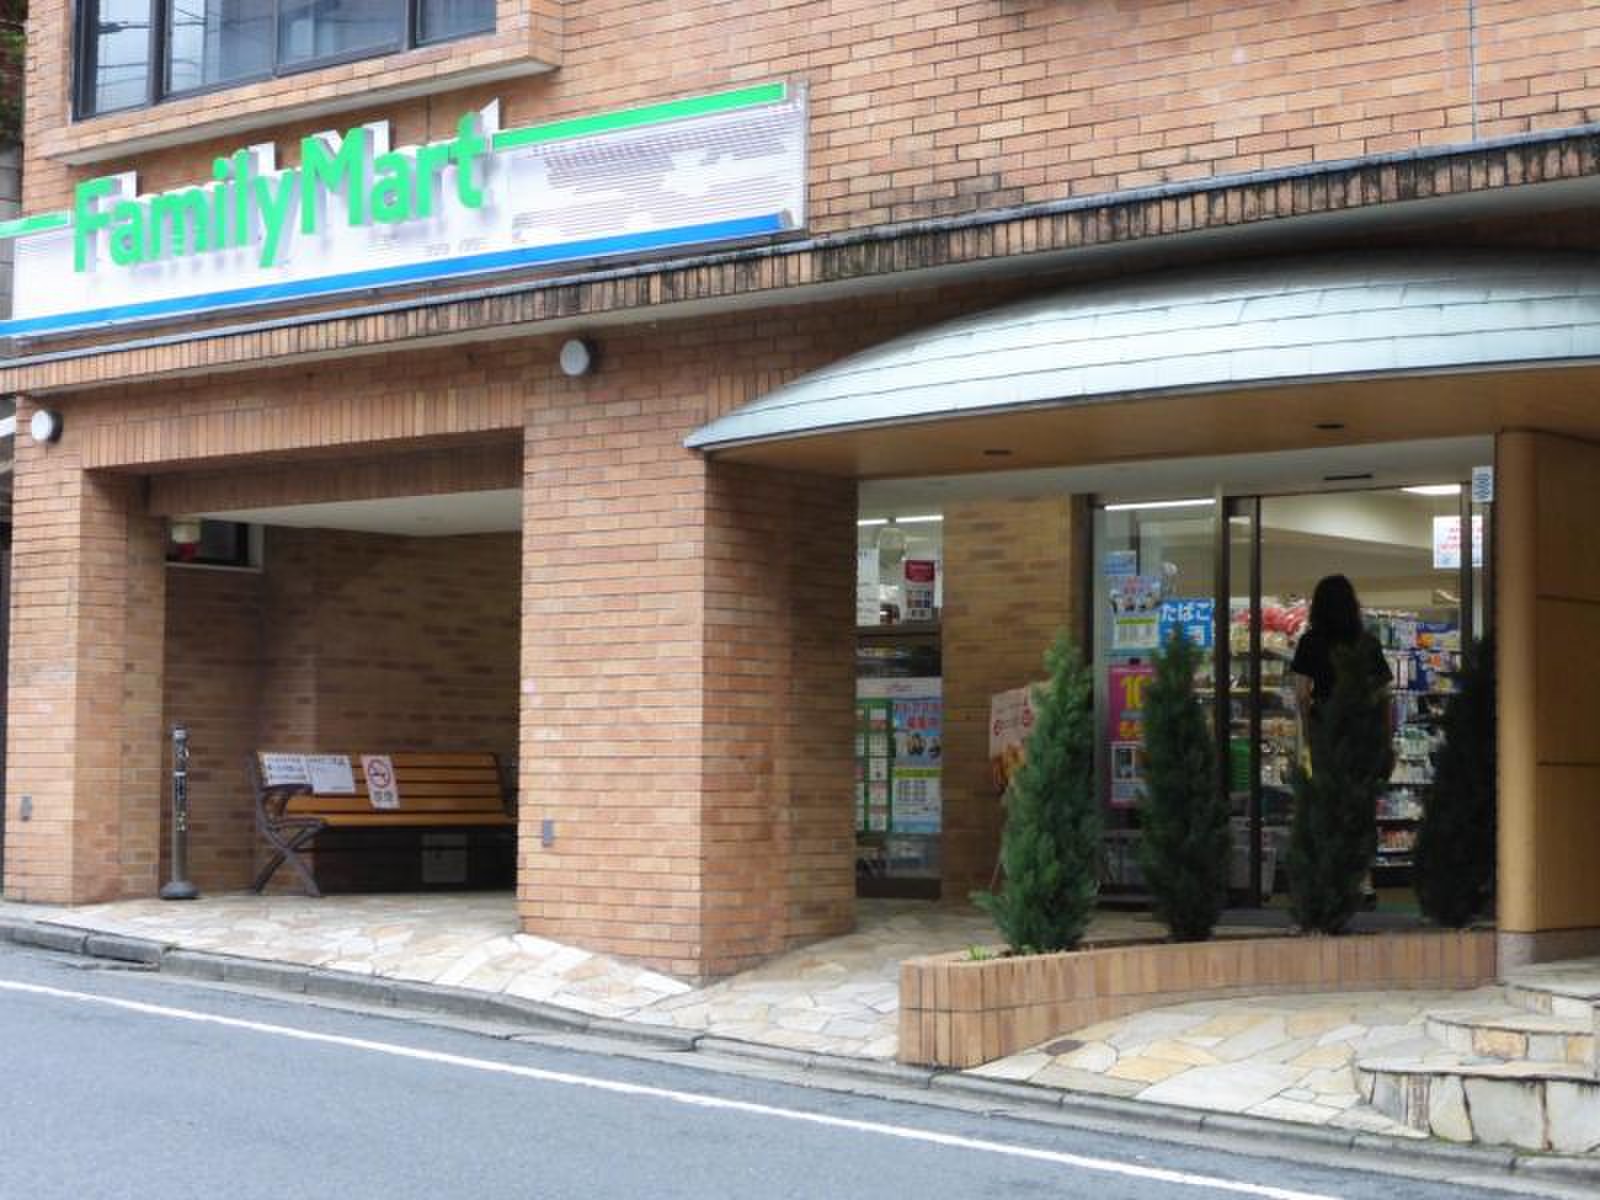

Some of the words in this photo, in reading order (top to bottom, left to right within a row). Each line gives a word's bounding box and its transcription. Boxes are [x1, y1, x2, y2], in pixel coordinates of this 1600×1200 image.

[73, 111, 487, 272] FamilyMart
[1160, 601, 1211, 621] たばこ
